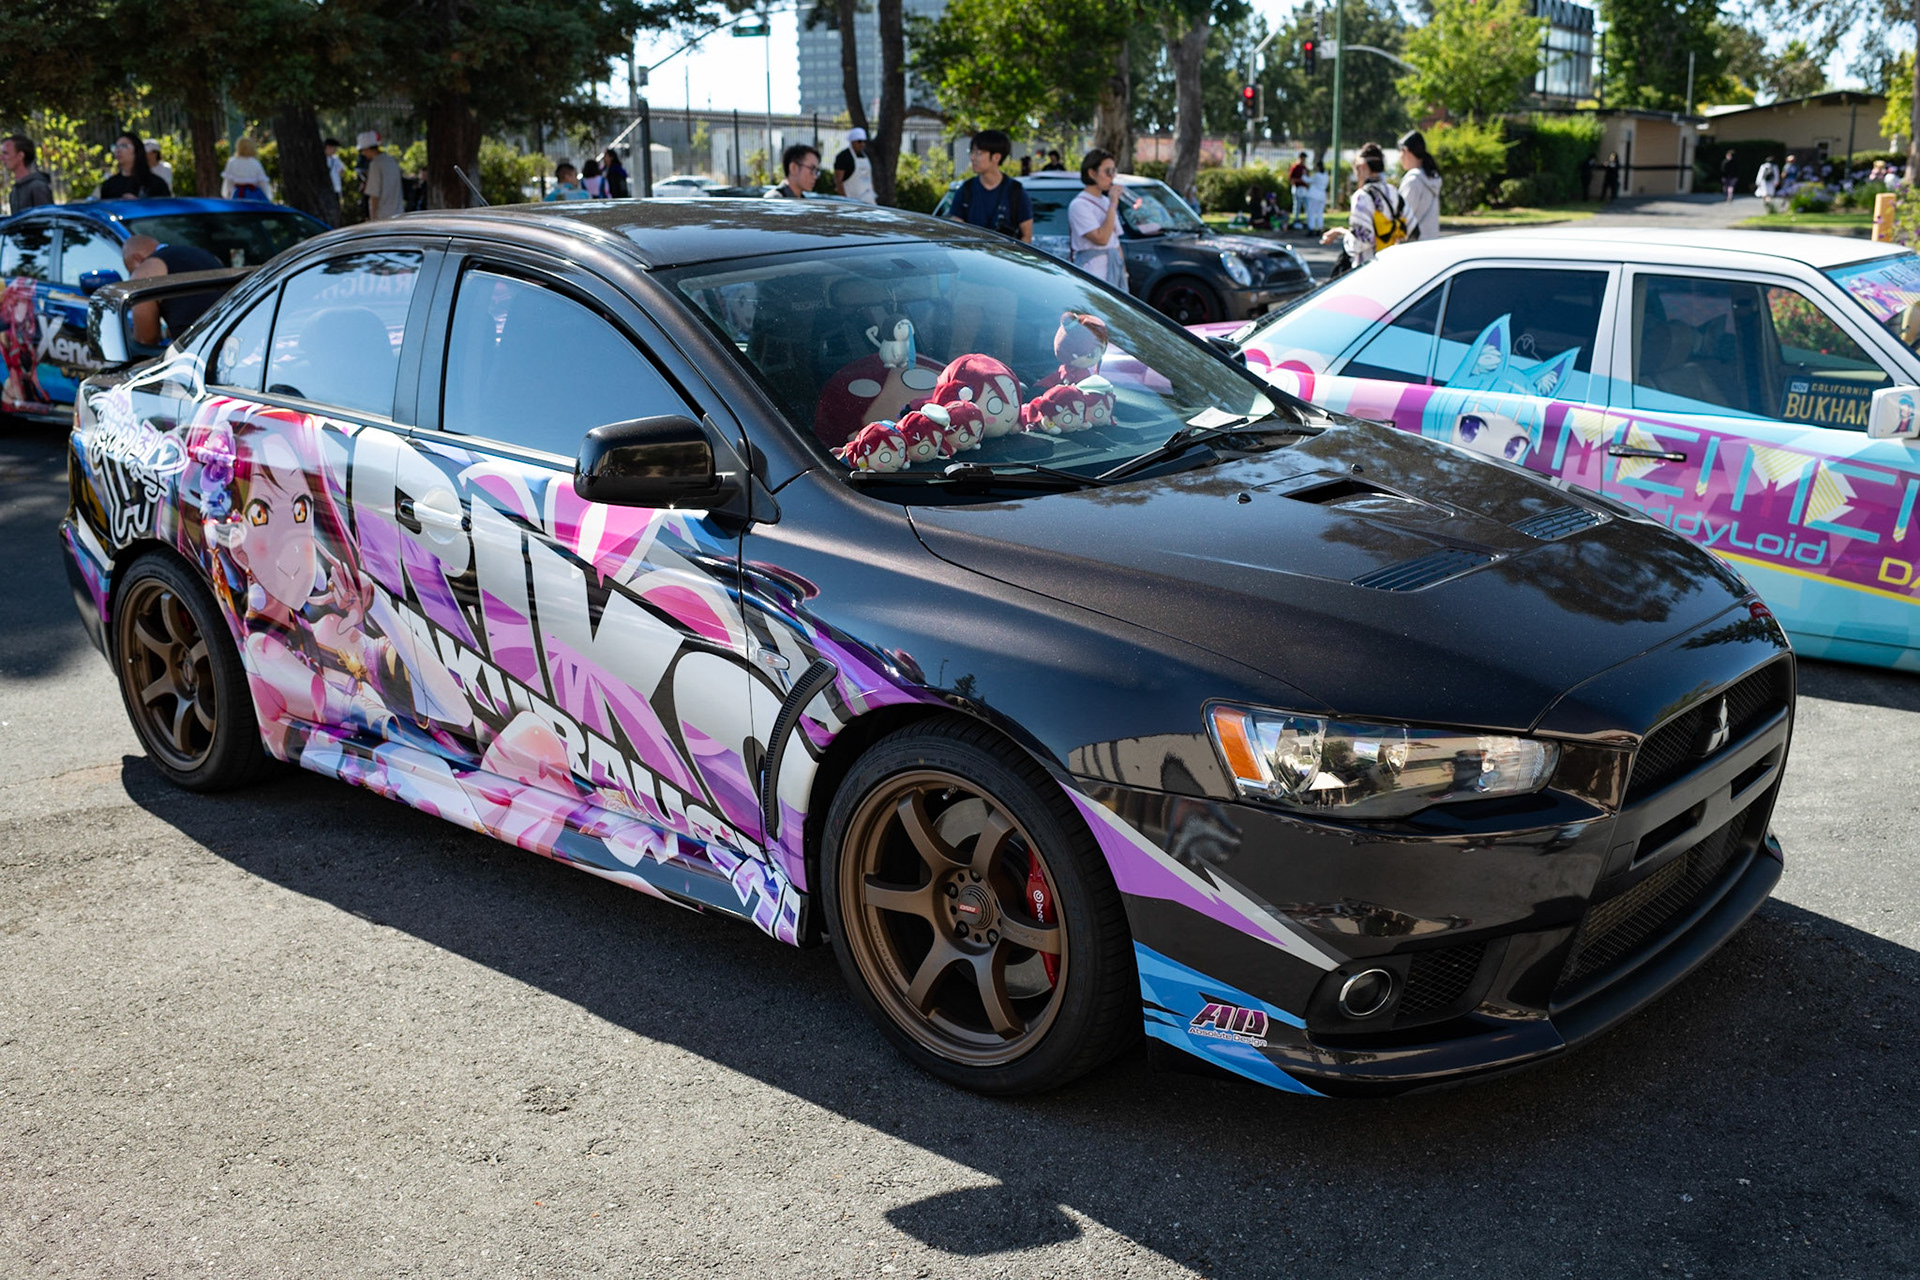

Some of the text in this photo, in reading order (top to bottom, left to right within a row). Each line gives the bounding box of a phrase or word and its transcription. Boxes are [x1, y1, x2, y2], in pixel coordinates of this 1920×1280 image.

[1811, 383, 1869, 396] CALIFORNIA
[1188, 1027, 1268, 1047] Absolute Design
